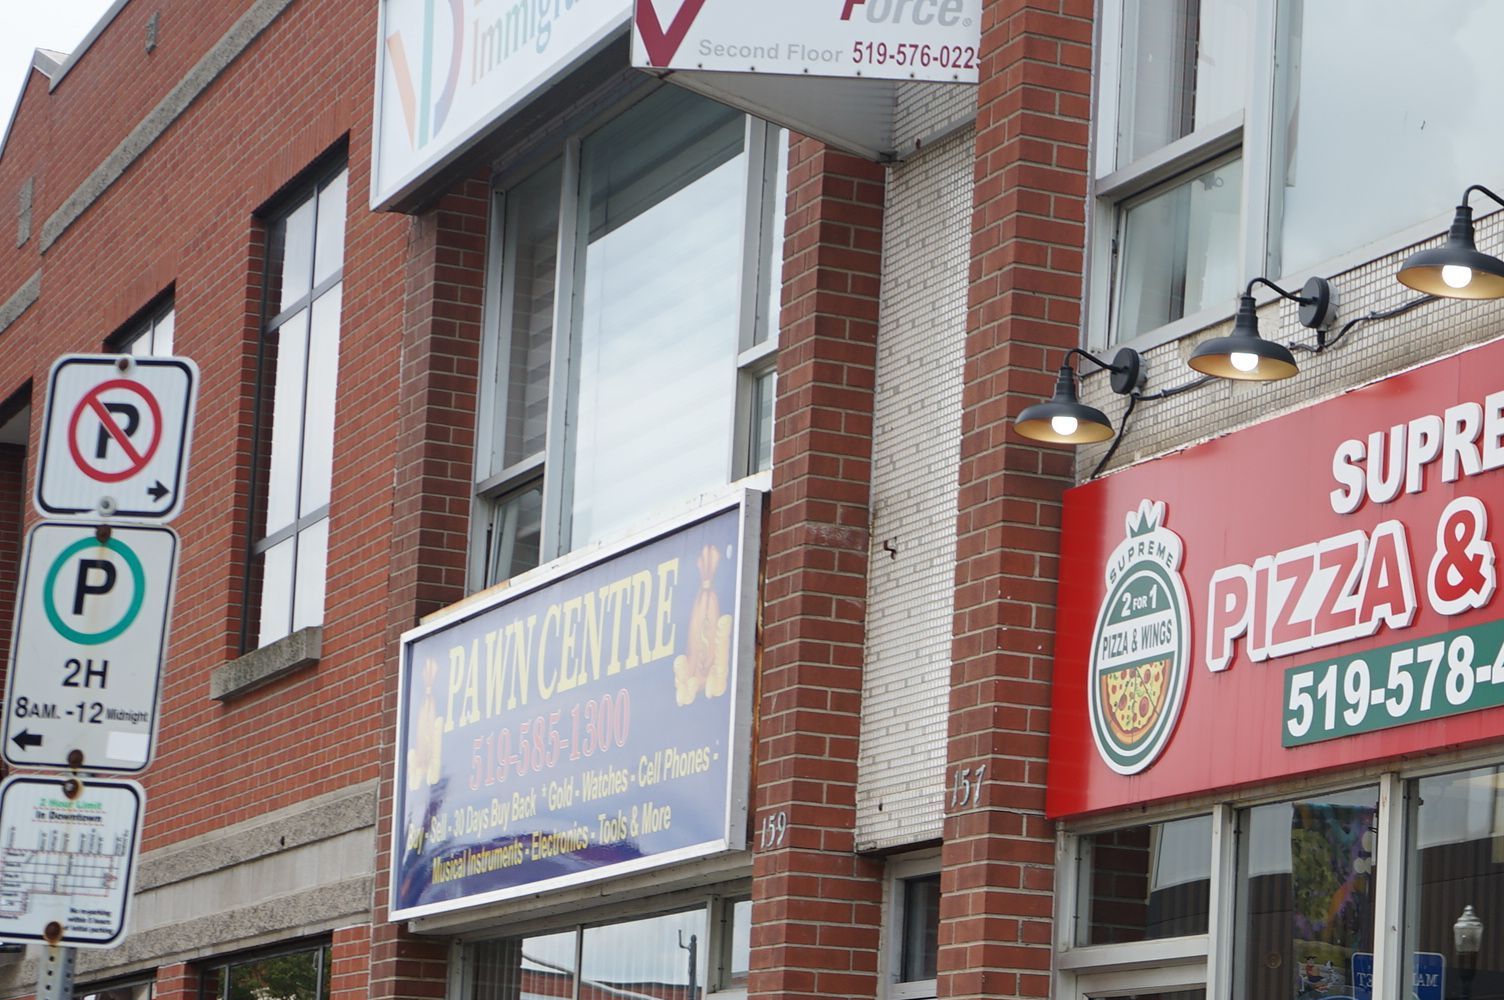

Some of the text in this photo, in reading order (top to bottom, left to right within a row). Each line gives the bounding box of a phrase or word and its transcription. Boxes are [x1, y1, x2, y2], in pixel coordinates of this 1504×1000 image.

[699, 39, 844, 63] Second Floor
[1109, 540, 1174, 585] SUPREME
[1207, 519, 1417, 672] PIZZA
[1428, 496, 1496, 615] &
[1121, 584, 1158, 617] 2 FOR 1
[444, 557, 679, 733] PAWN CENTRE
[1102, 618, 1172, 660] PIZZA & WINGS
[62, 658, 109, 689] 2H
[105, 708, 148, 724] Midnight
[468, 686, 631, 793] 519-585-1300
[430, 813, 447, 843] Sell
[453, 808, 465, 837] 30
[466, 805, 489, 837] Days
[491, 798, 511, 831] Buy
[512, 787, 536, 821] Back
[549, 775, 574, 811] Gold
[582, 765, 629, 802] Watches
[638, 751, 662, 787] Cell
[663, 745, 710, 781] Phones
[951, 764, 987, 808] 157
[432, 802, 672, 885] Musical Instruments Electronics Tools & More
[760, 811, 787, 849] 159
